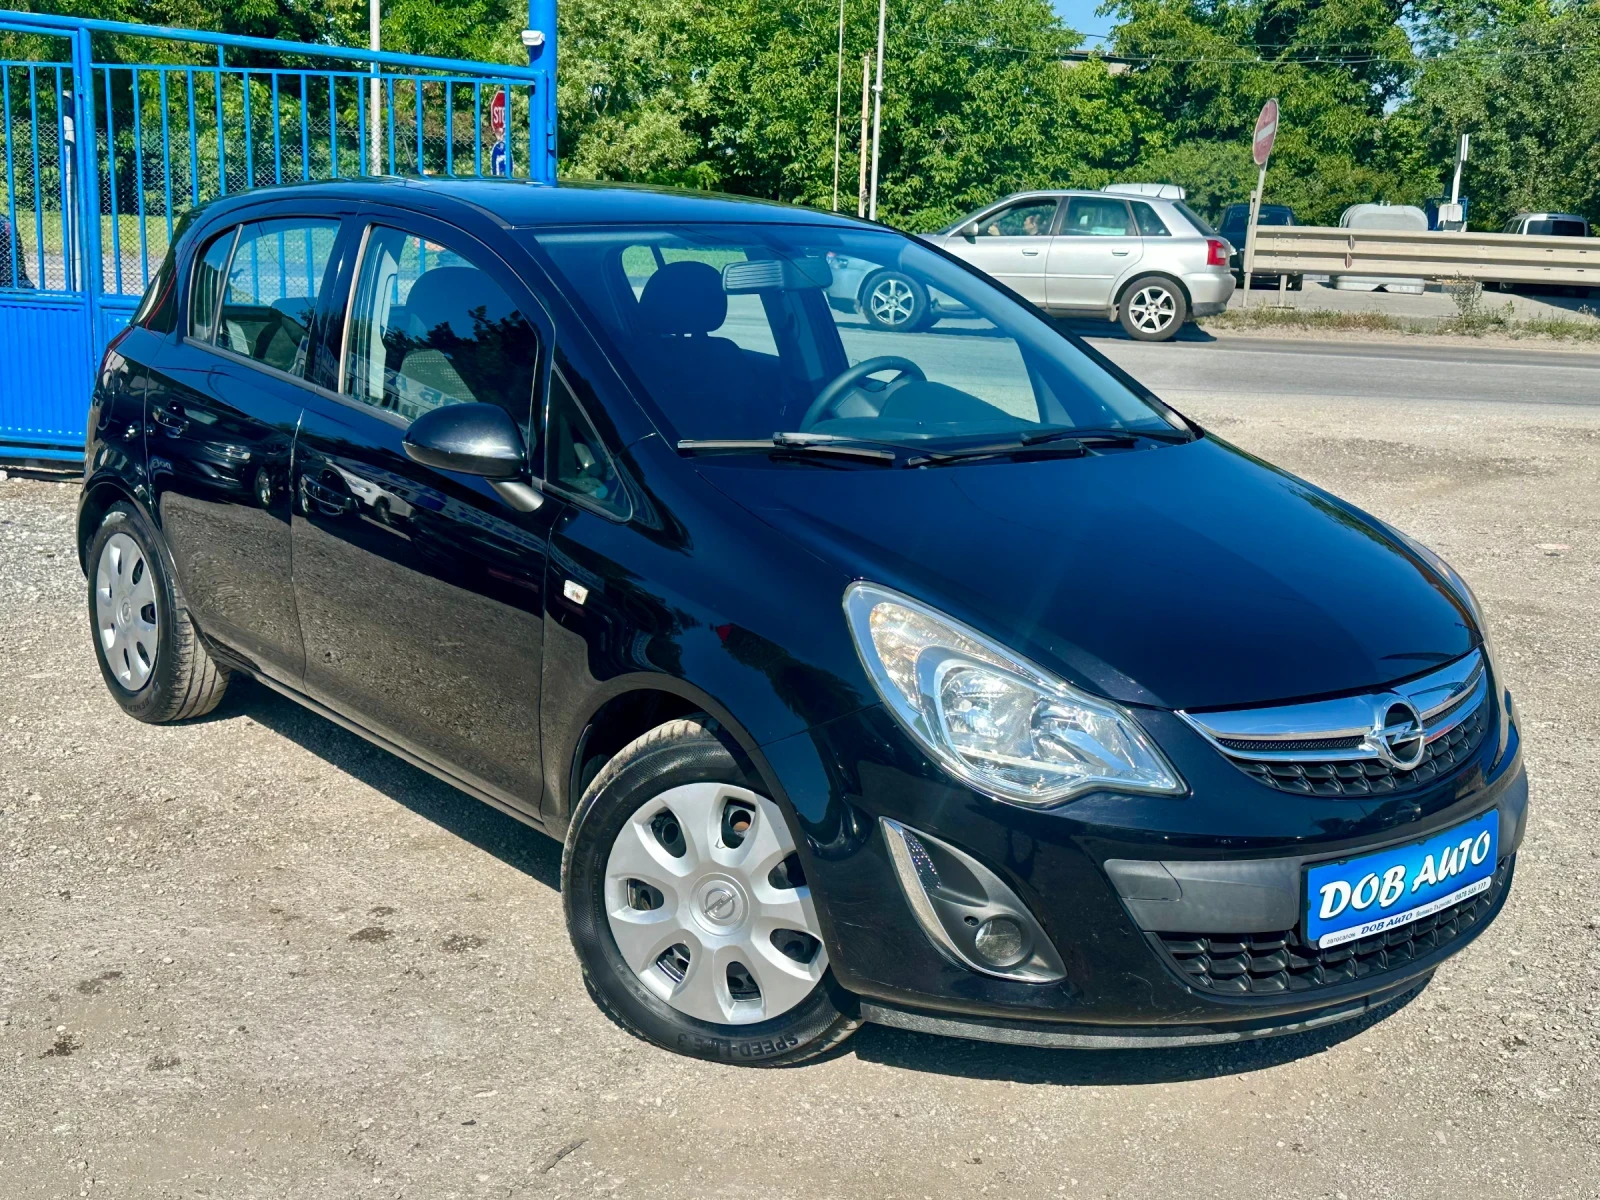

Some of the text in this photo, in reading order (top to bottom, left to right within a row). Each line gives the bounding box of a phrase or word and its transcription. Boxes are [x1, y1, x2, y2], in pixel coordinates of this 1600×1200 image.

[1319, 830, 1490, 919] DOB AUTO
[1361, 922, 1385, 935] DOB
[1386, 912, 1413, 928] AUTO
